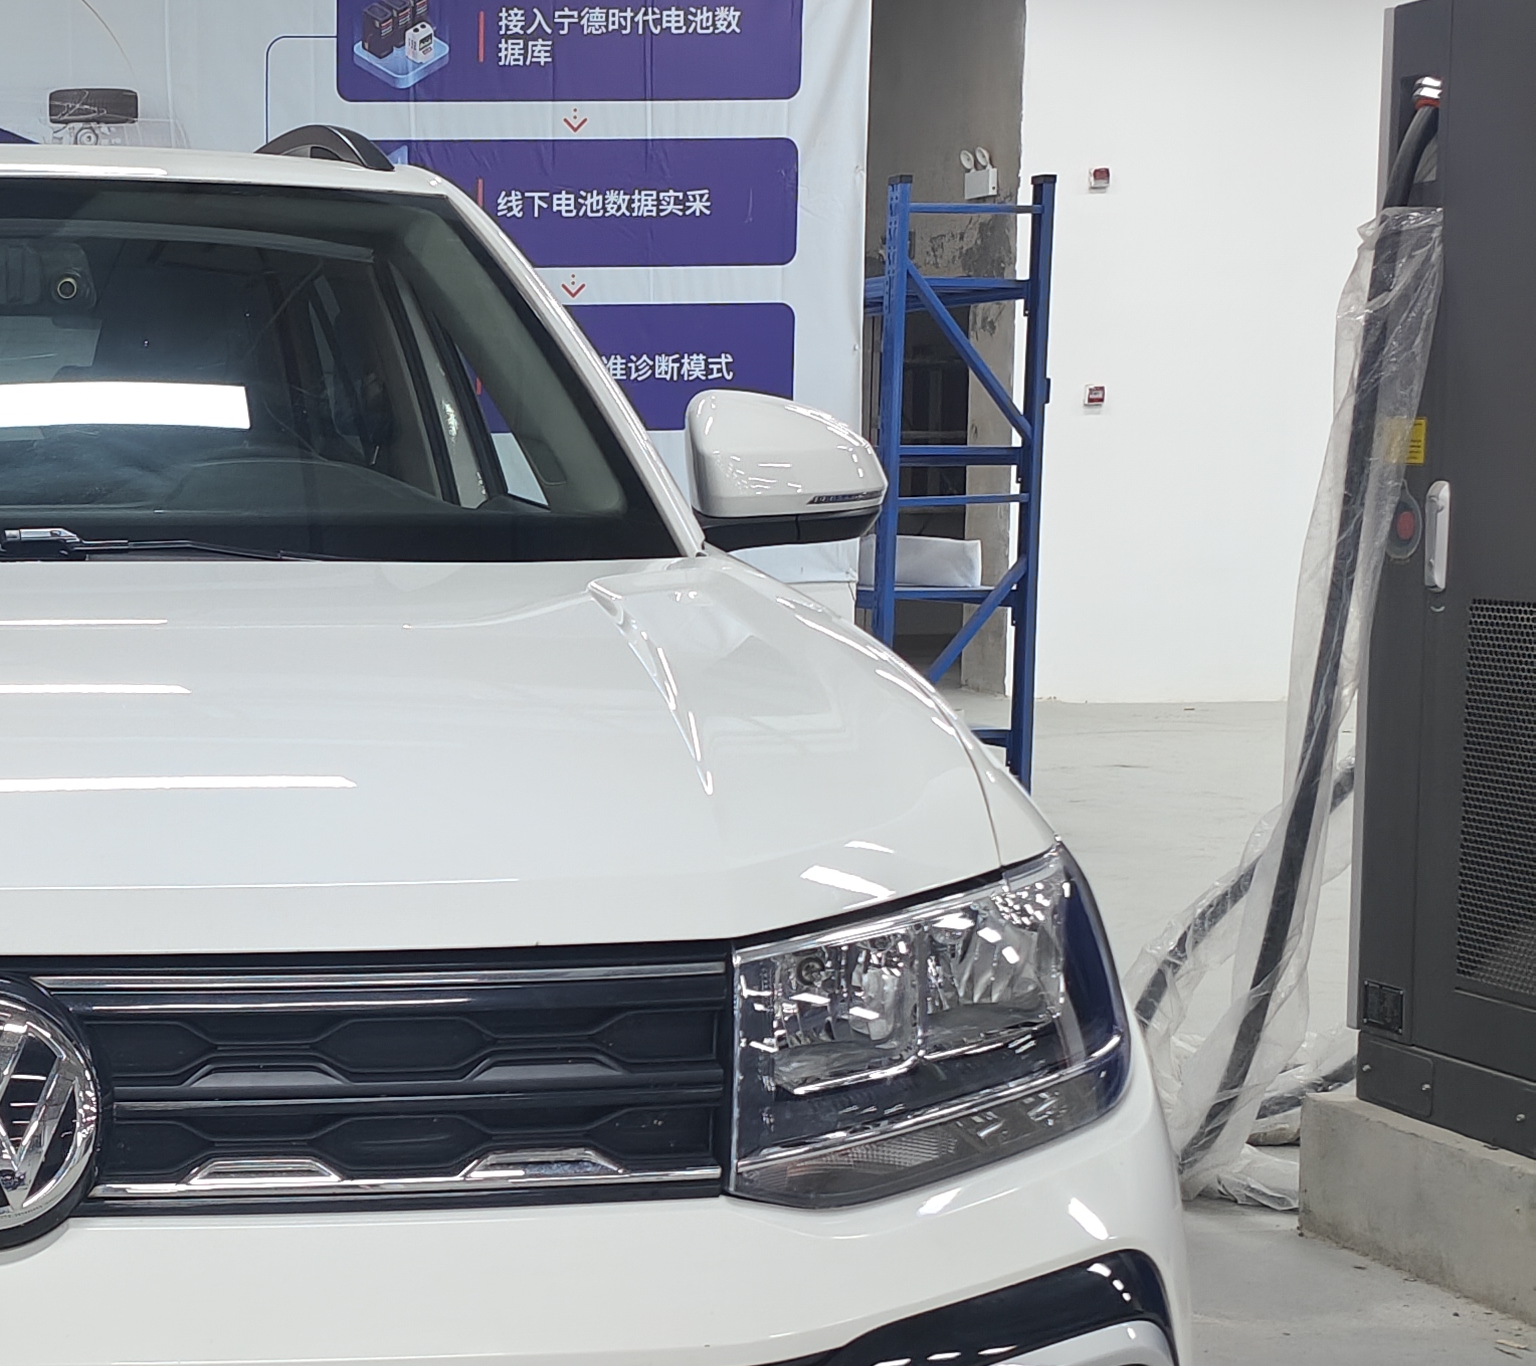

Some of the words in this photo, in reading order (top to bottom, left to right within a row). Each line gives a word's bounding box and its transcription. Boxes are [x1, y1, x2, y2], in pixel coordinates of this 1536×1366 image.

[498, 7, 741, 35] 接入宁德时代电池数
[498, 39, 552, 66] 据库
[497, 189, 711, 218] 线下电池数据实采
